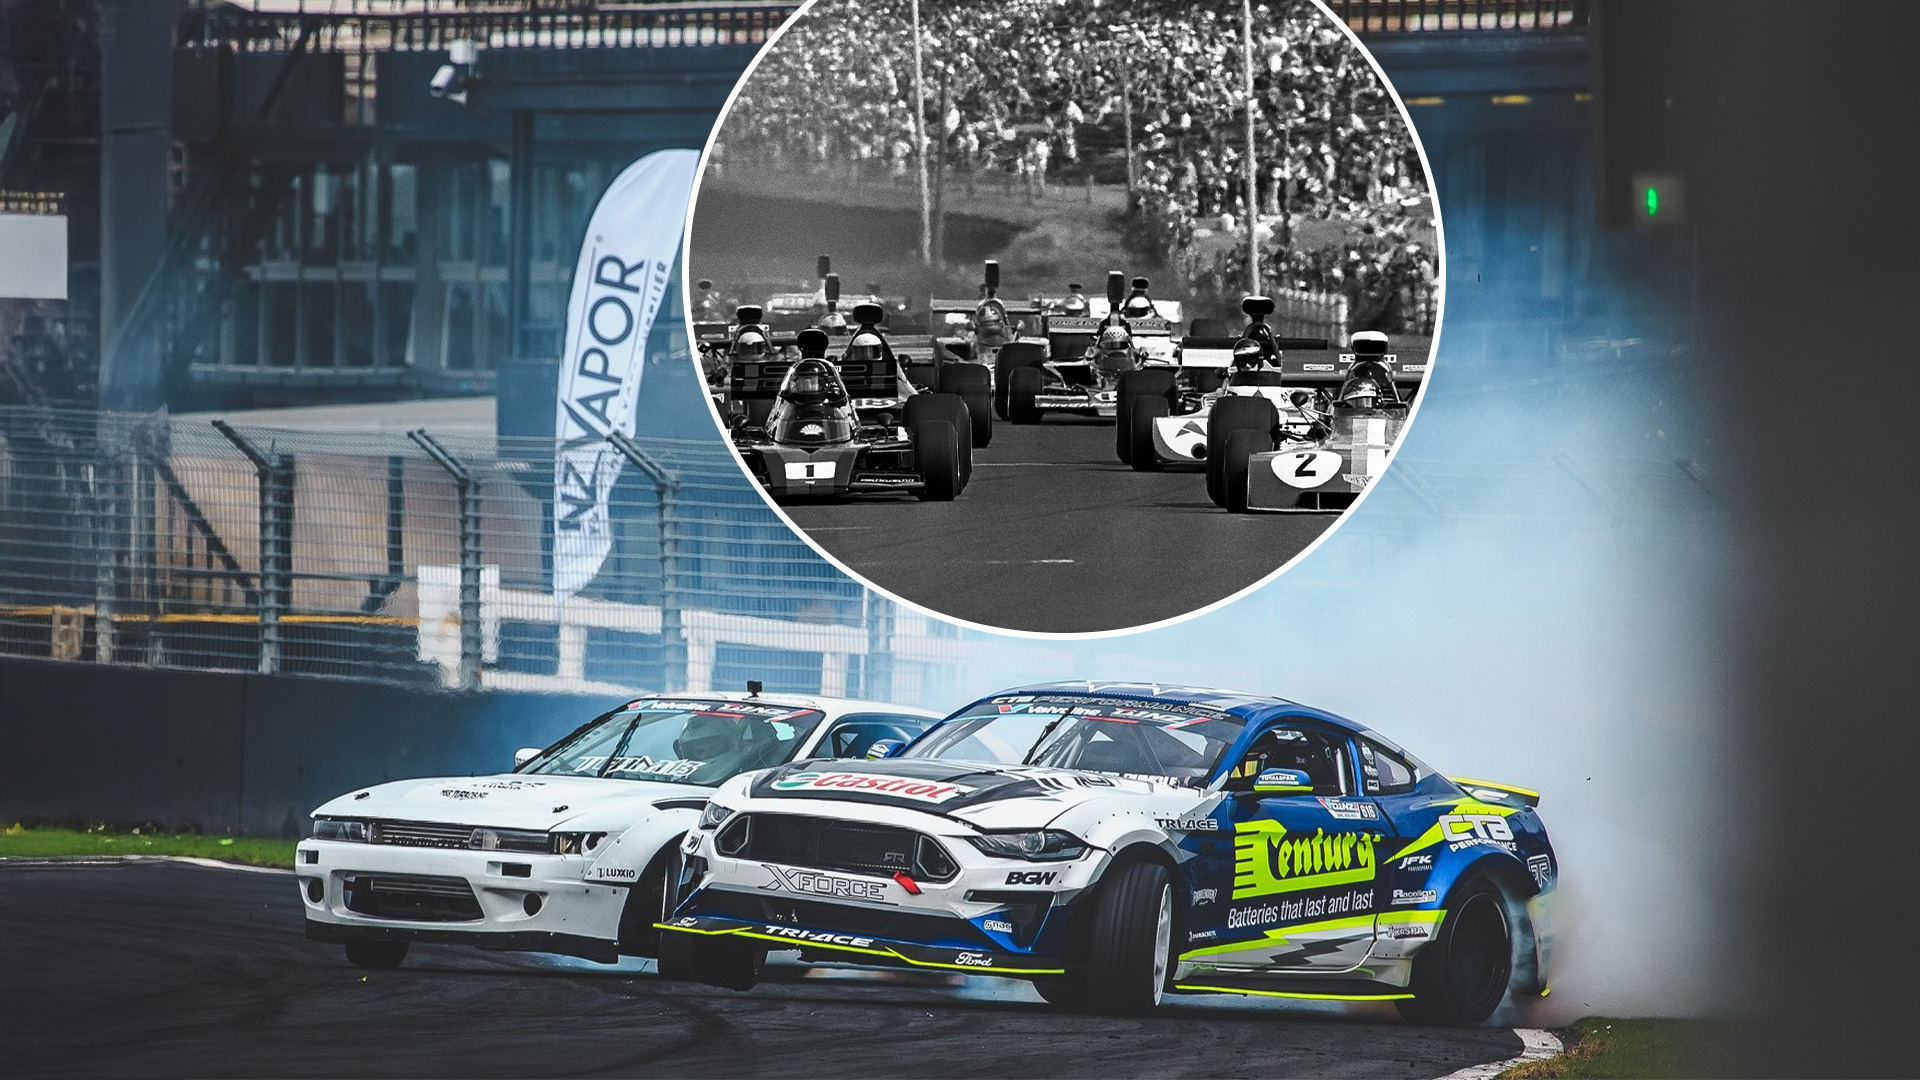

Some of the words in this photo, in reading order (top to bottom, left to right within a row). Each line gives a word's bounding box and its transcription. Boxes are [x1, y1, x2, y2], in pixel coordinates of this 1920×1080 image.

[805, 464, 814, 478] 1
[1294, 453, 1317, 478] 2
[814, 774, 955, 799] Castrol
[1154, 818, 1219, 831] TRI-ACE
[1232, 818, 1376, 900] Century
[1399, 855, 1432, 869] JFK
[606, 868, 636, 879] LUXXIO
[1005, 872, 1058, 885] BGW
[1228, 907, 1278, 929] Batteries
[1280, 902, 1303, 921] that
[1304, 899, 1327, 917] last
[1328, 896, 1350, 915] and
[1351, 888, 1375, 910] last
[765, 925, 874, 947] TRI-ACE
[955, 952, 992, 966] Ford
